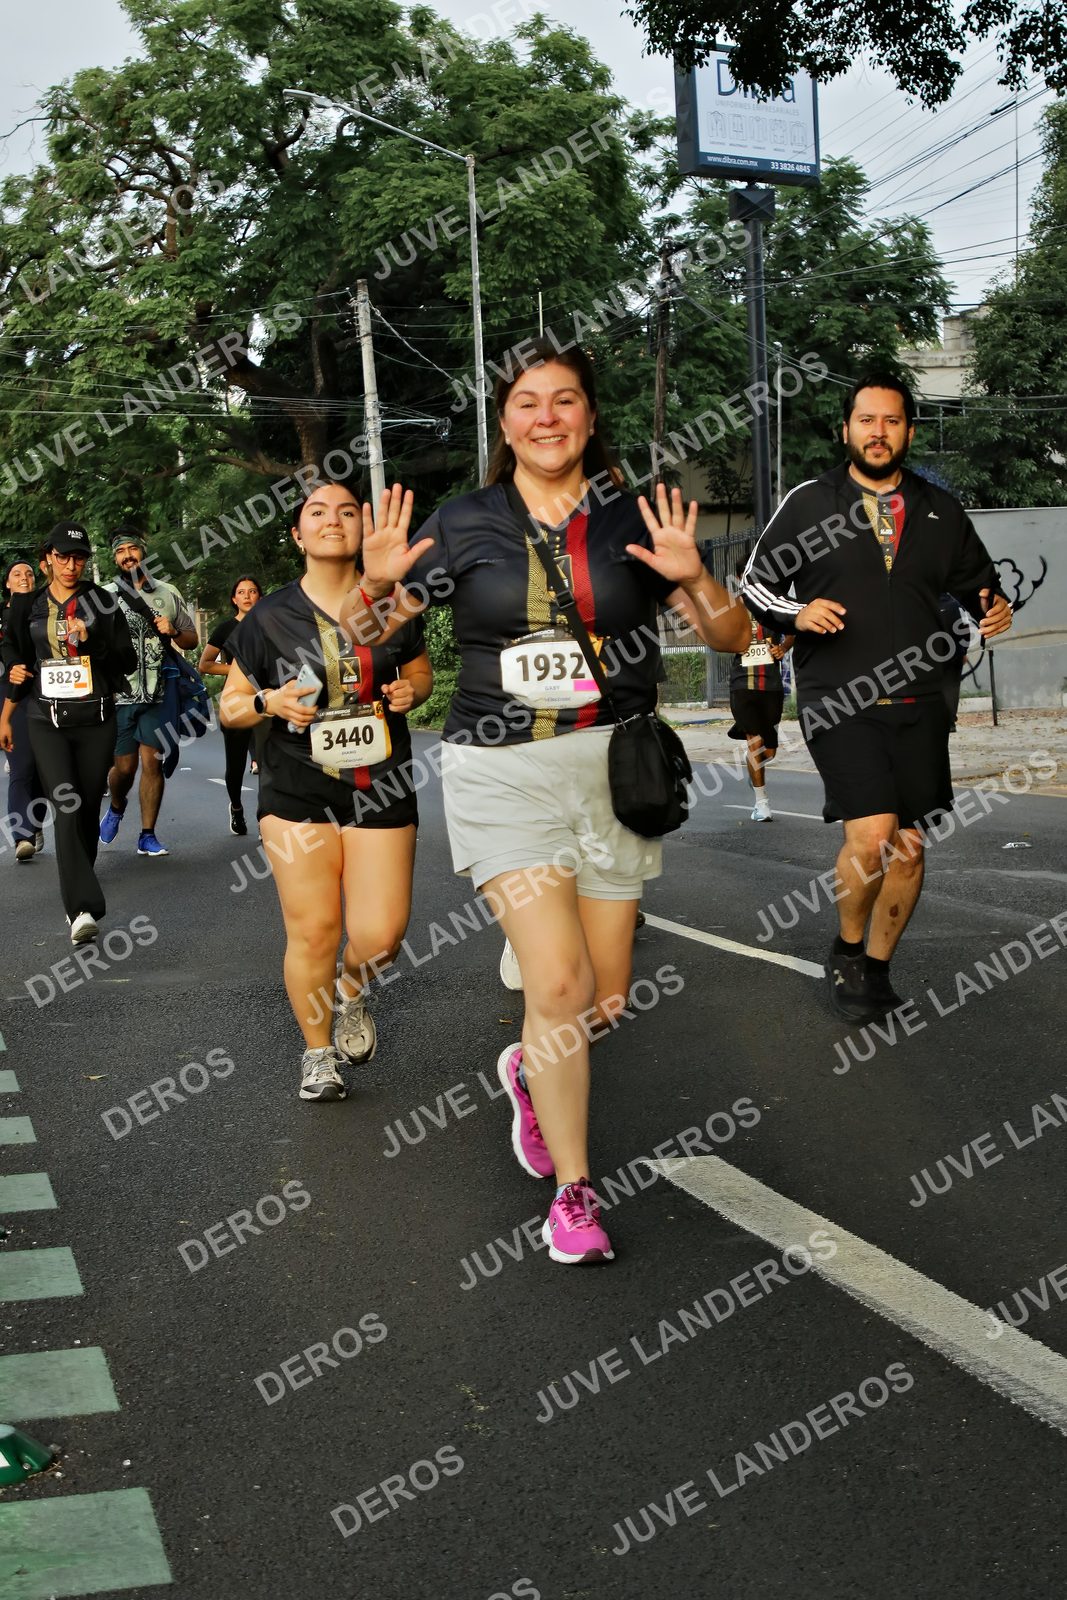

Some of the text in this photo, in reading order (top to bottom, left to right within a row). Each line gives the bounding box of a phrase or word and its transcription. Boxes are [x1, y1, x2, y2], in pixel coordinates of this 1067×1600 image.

[715, 100, 752, 110] UNIFORMES
[707, 155, 759, 167] www.dibra.com.mx
[770, 162, 779, 170] 33
[516, 652, 586, 682] 1932
[48, 670, 81, 684] 3829
[322, 724, 374, 751] 3440
